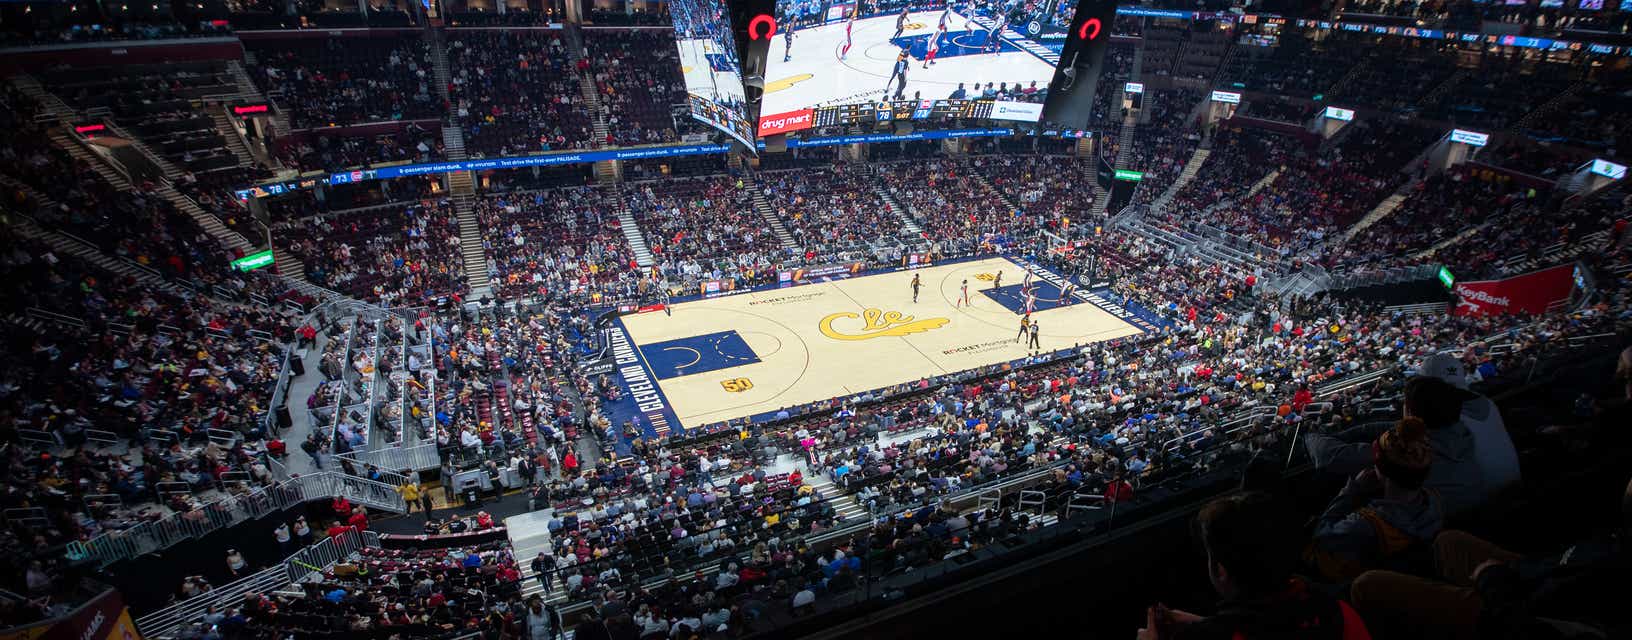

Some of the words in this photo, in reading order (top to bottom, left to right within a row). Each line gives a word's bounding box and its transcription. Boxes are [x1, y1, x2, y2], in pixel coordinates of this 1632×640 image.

[761, 118, 785, 129] drug
[786, 114, 810, 125] mart
[879, 111, 890, 119] 78
[917, 109, 928, 118] 73
[269, 185, 282, 195] 78
[335, 173, 348, 183] 73
[1456, 284, 1510, 306] KeyBank
[818, 307, 950, 341] Cle
[610, 327, 639, 365] CAVALIERS
[594, 363, 613, 371] CLIFFS
[620, 364, 665, 413] CLEVELAND
[720, 377, 754, 393] 50
